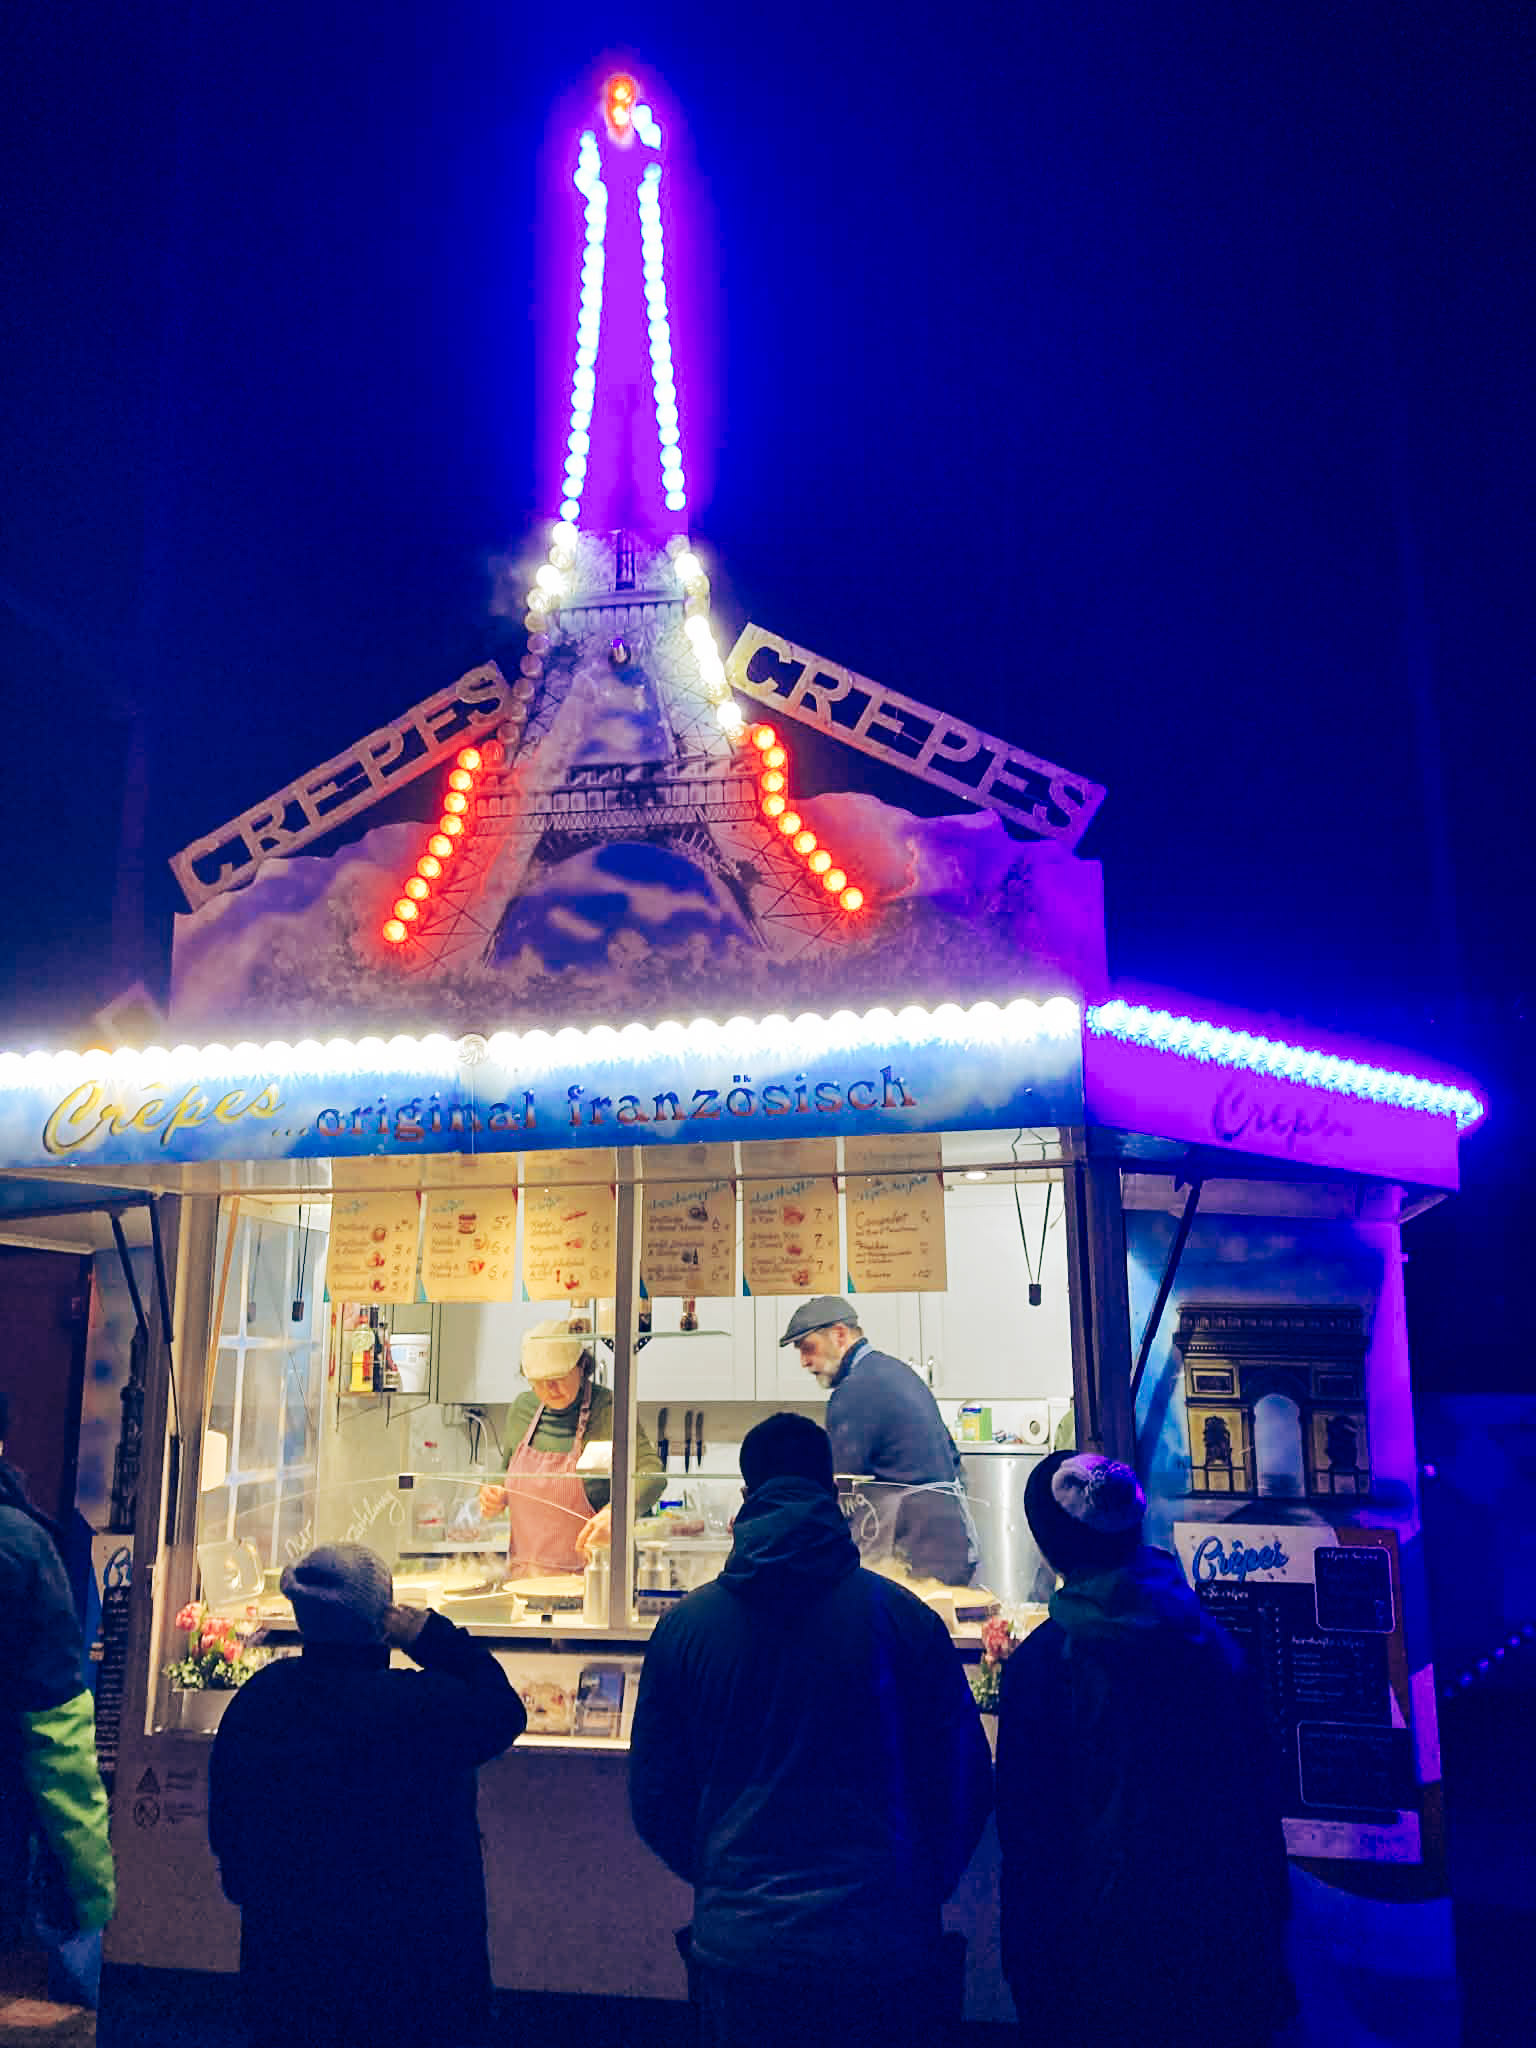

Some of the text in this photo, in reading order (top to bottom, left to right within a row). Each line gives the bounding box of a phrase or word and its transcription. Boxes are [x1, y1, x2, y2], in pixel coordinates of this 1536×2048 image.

[174, 662, 505, 904] CREPES
[731, 630, 1104, 844] CREPES
[42, 1080, 286, 1155] Crêpes
[567, 1064, 918, 1128] französisch
[1192, 1535, 1290, 1584] Crêpes
